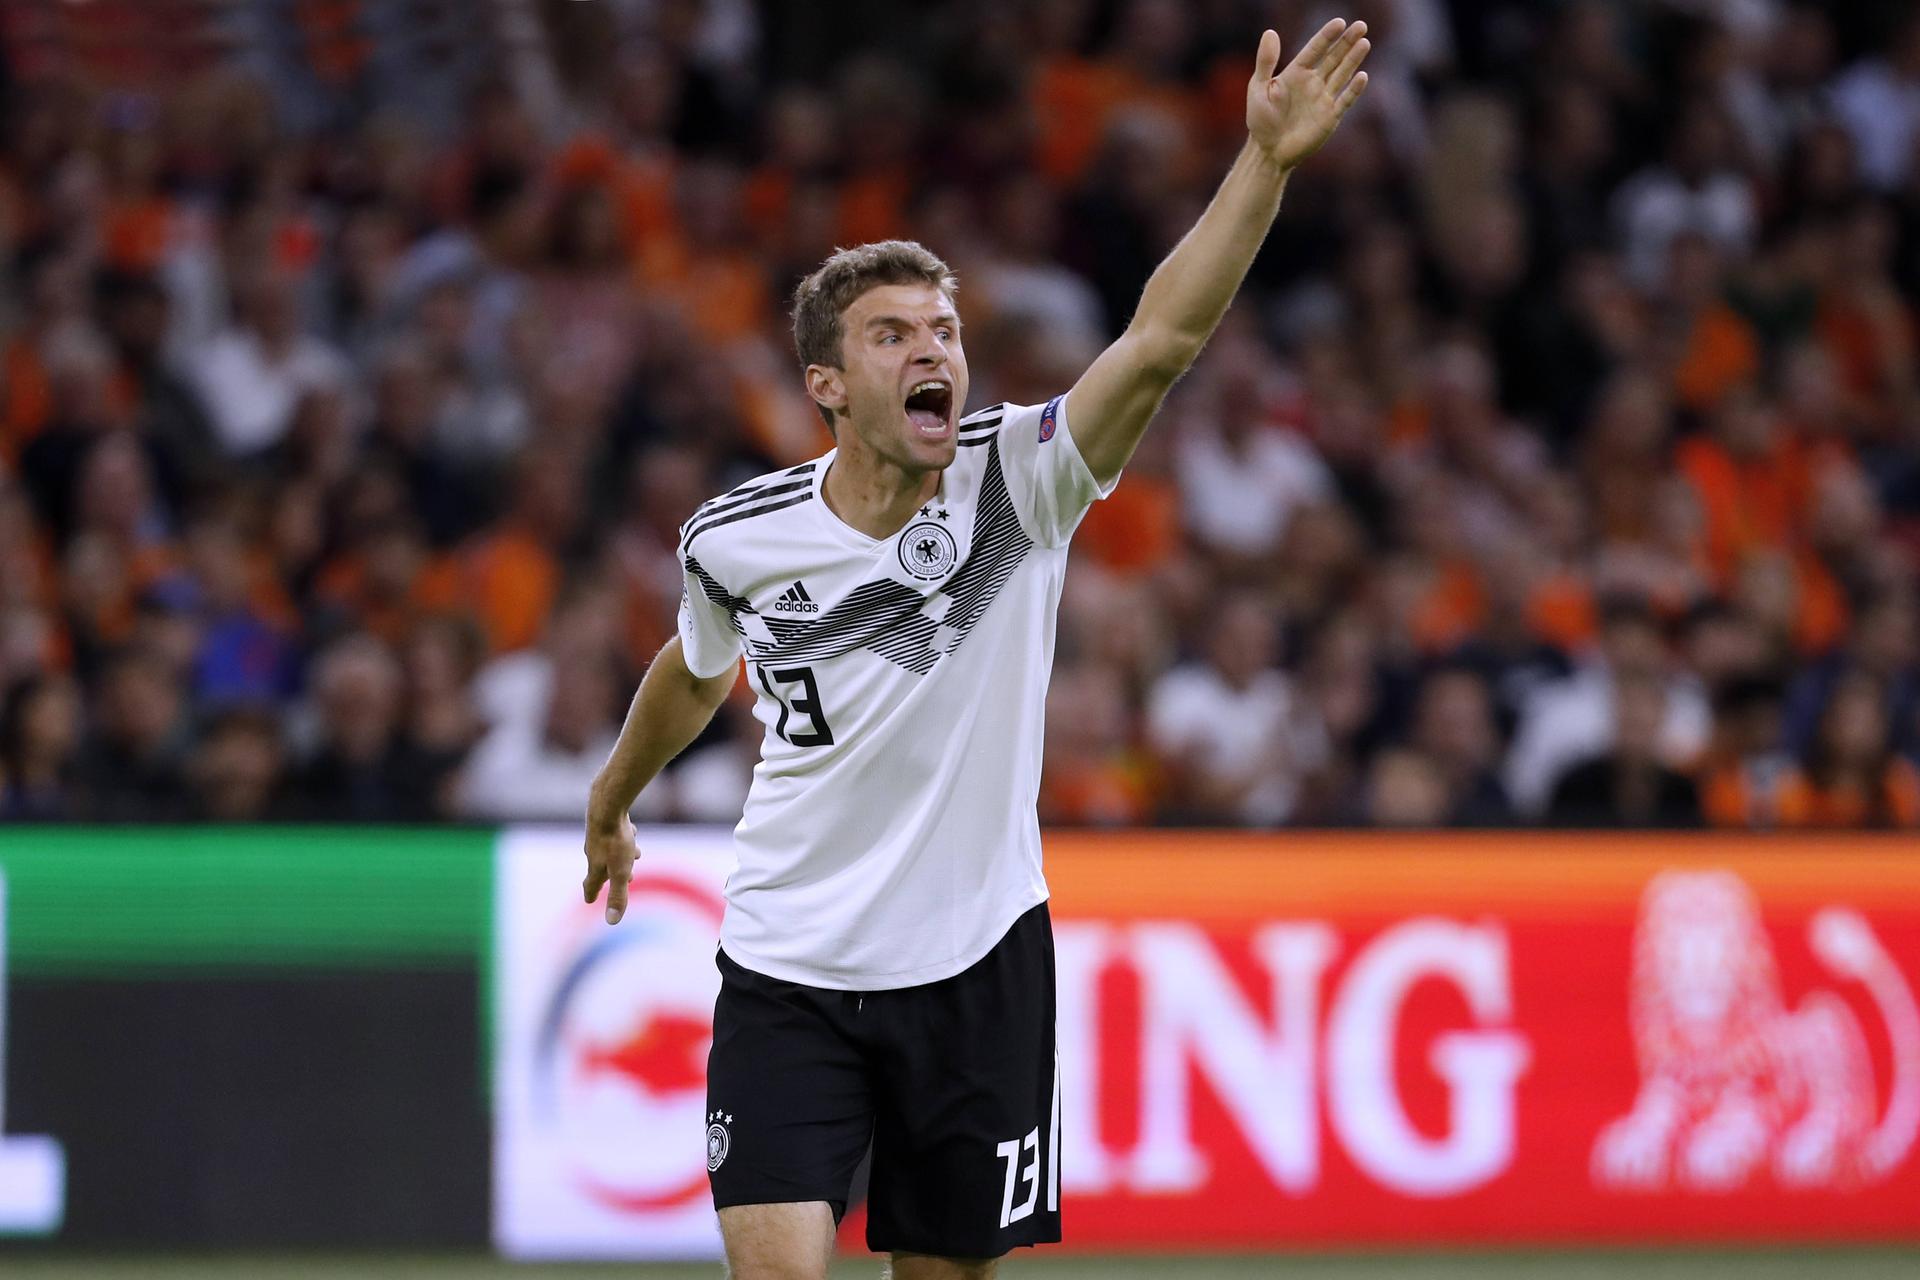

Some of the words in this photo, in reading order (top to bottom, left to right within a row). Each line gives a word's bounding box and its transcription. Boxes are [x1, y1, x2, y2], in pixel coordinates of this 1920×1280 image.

[774, 600, 819, 613] adidas
[756, 661, 835, 747] 13
[1053, 917, 1531, 1197] ING
[996, 1125, 1040, 1229] 13
